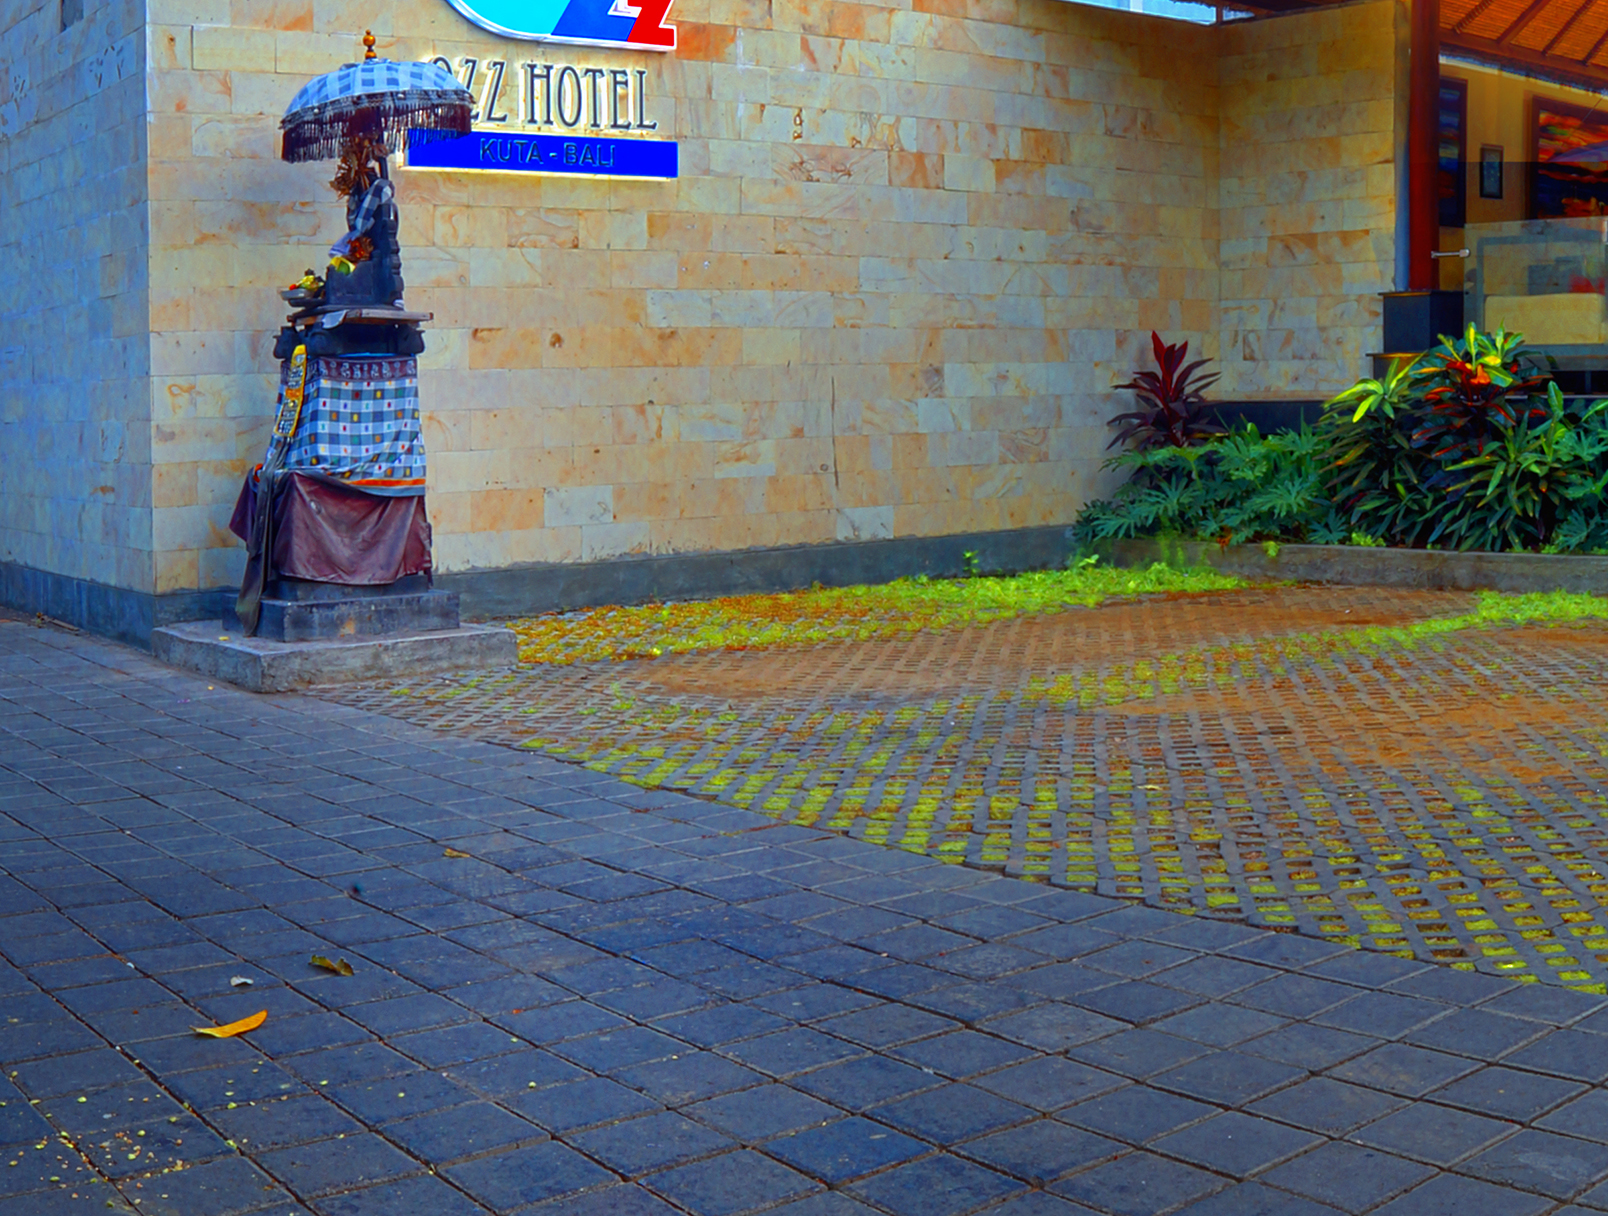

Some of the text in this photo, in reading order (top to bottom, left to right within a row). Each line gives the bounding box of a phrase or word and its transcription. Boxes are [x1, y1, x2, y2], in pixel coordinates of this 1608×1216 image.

[524, 63, 658, 130] HOTEL
[480, 138, 543, 164] KUTA
[563, 142, 615, 167] BALI
